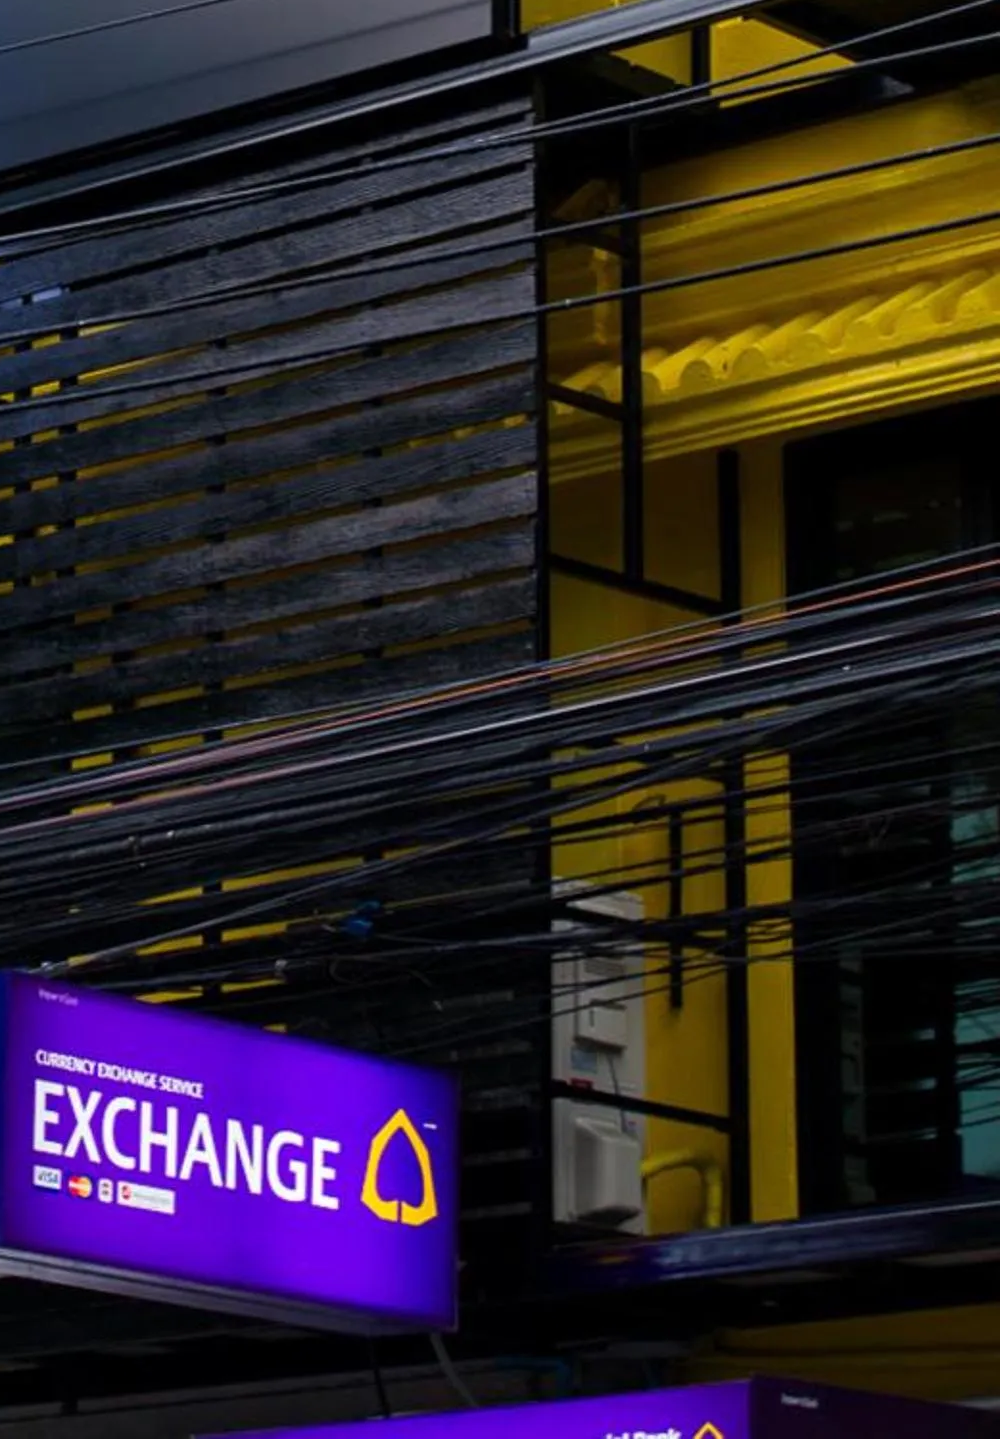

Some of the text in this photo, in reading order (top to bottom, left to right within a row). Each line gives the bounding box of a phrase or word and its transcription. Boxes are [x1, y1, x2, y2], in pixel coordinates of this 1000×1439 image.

[35, 1049, 204, 1098] CURRENCY EXCHANGE SERVICE
[33, 1078, 341, 1210] EXCHANGE
